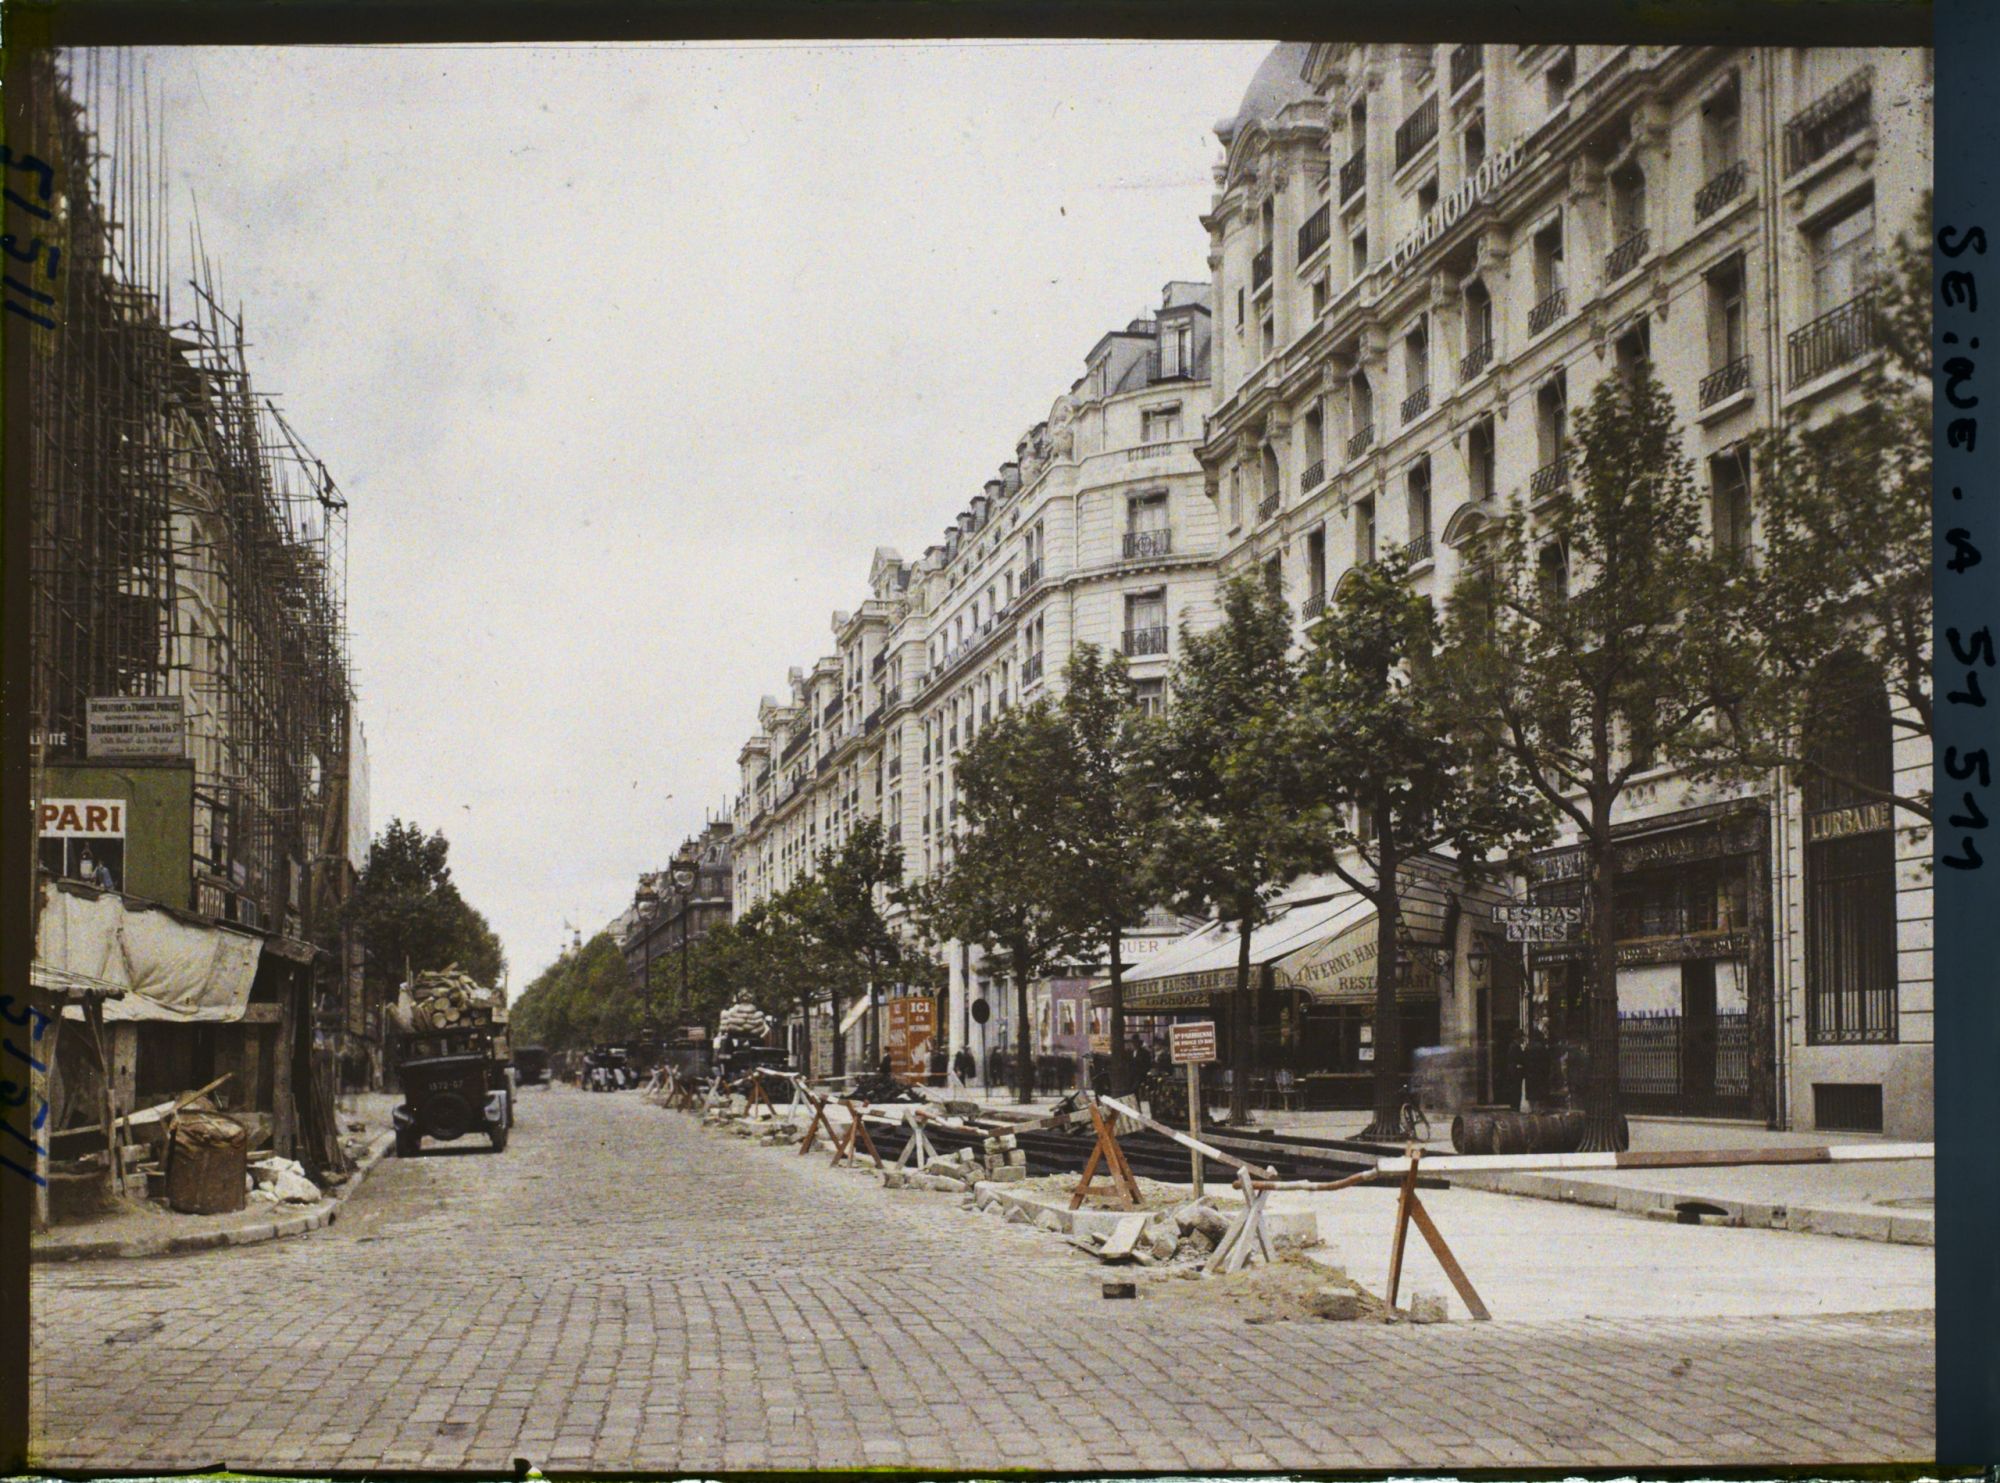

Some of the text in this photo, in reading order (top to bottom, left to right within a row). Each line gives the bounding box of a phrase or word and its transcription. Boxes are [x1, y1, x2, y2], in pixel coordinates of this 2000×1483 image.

[1391, 138, 1525, 272] COMMODORE
[39, 804, 121, 832] PARI
[1494, 906, 1579, 922] LES BAS
[910, 1002, 930, 1014] ICI
